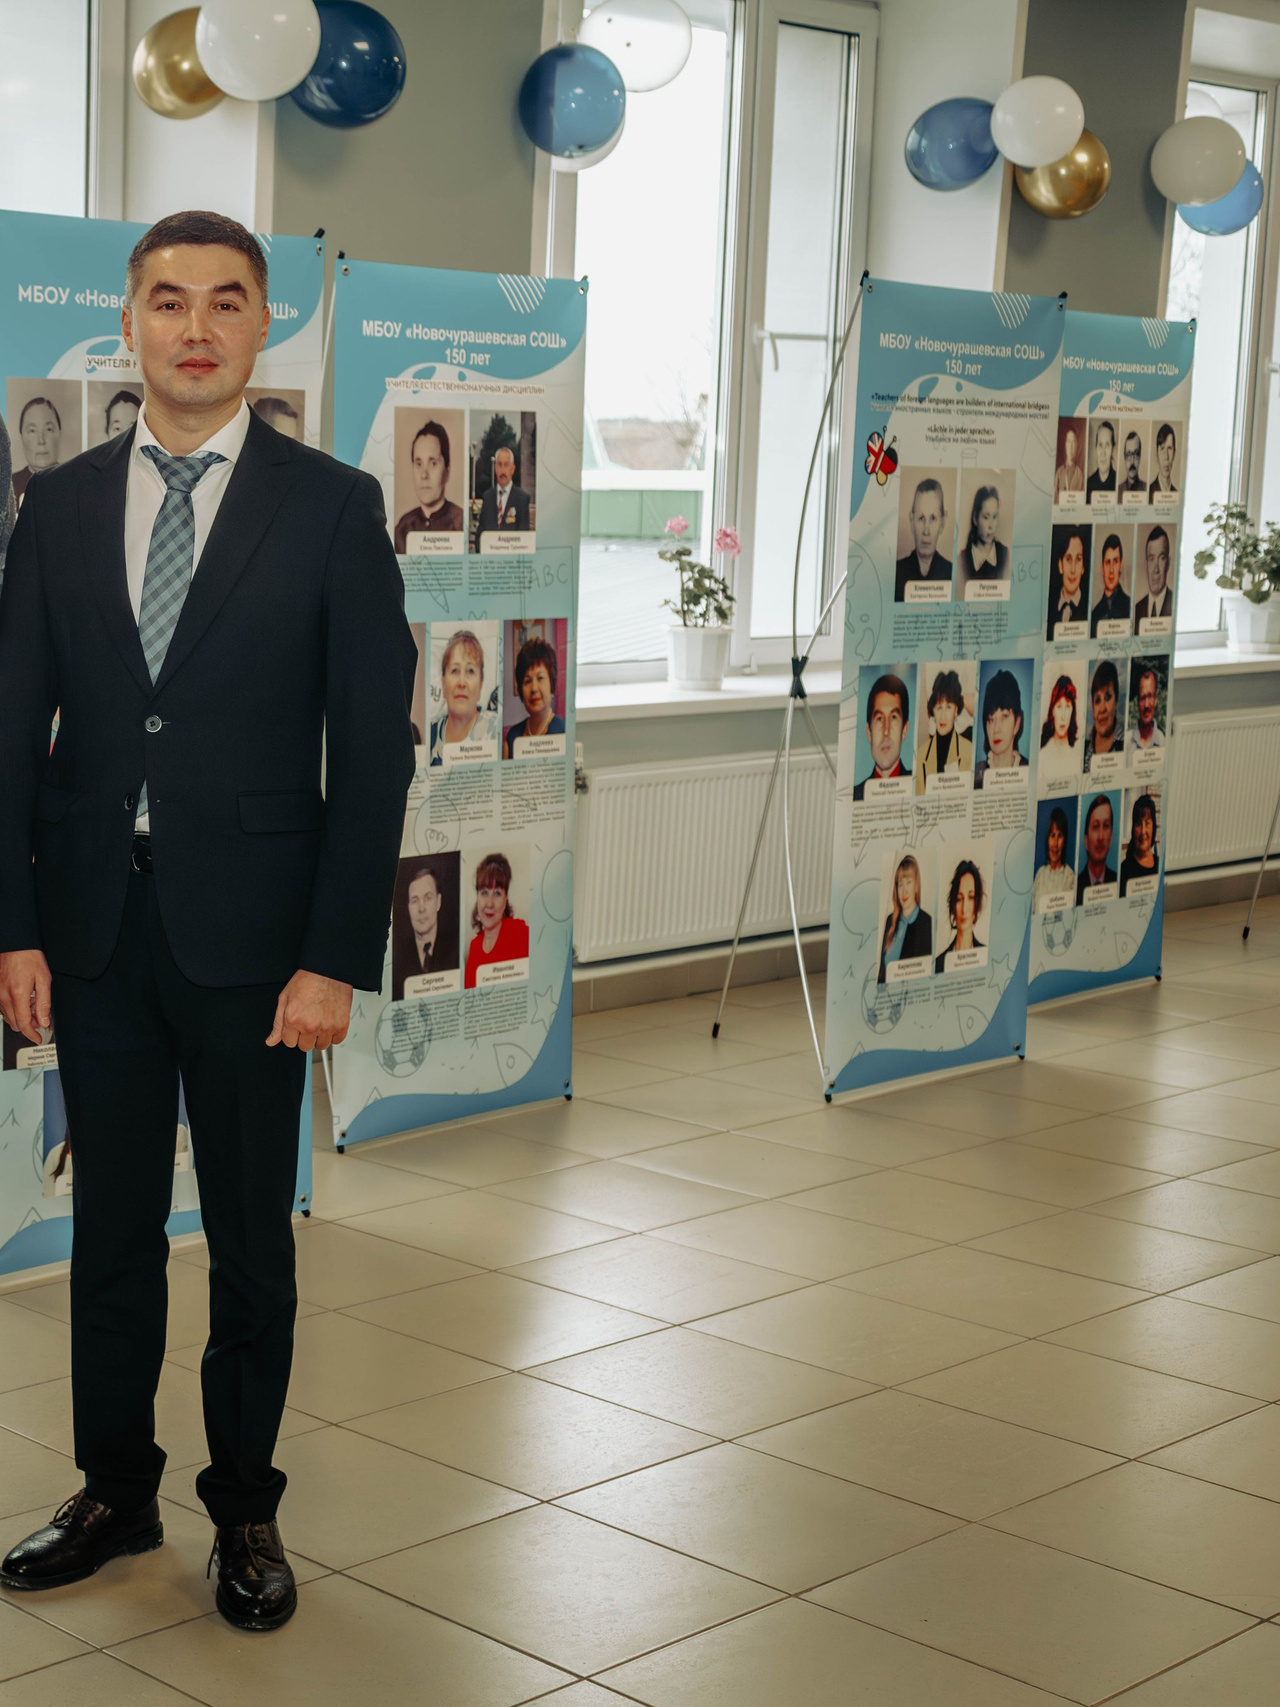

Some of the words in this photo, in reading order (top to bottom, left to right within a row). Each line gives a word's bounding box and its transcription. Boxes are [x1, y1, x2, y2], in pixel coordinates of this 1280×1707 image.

[17, 283, 71, 306] МБОУ
[74, 288, 127, 309] «Ново
[362, 319, 403, 339] МБОУ
[405, 322, 527, 347] «Новочурашевская
[529, 331, 567, 349] СОШ»
[879, 332, 912, 351] МБОУ
[914, 336, 1012, 358] «Новочурашевская
[1013, 343, 1046, 360] СОШ»
[86, 357, 131, 369] УЧИТЕЛЯ
[445, 347, 467, 365] 150
[469, 352, 491, 366] лет
[1062, 356, 1085, 370] МБОУ
[1086, 358, 1156, 375] «Новочурашевская
[1157, 363, 1179, 376] СОШ»
[945, 359, 963, 375] 150
[964, 363, 983, 376] лет
[387, 380, 420, 389] УЧИТЕЛЯ
[502, 384, 545, 395] ДИСЦИПЛИН
[1109, 379, 1122, 392] 150
